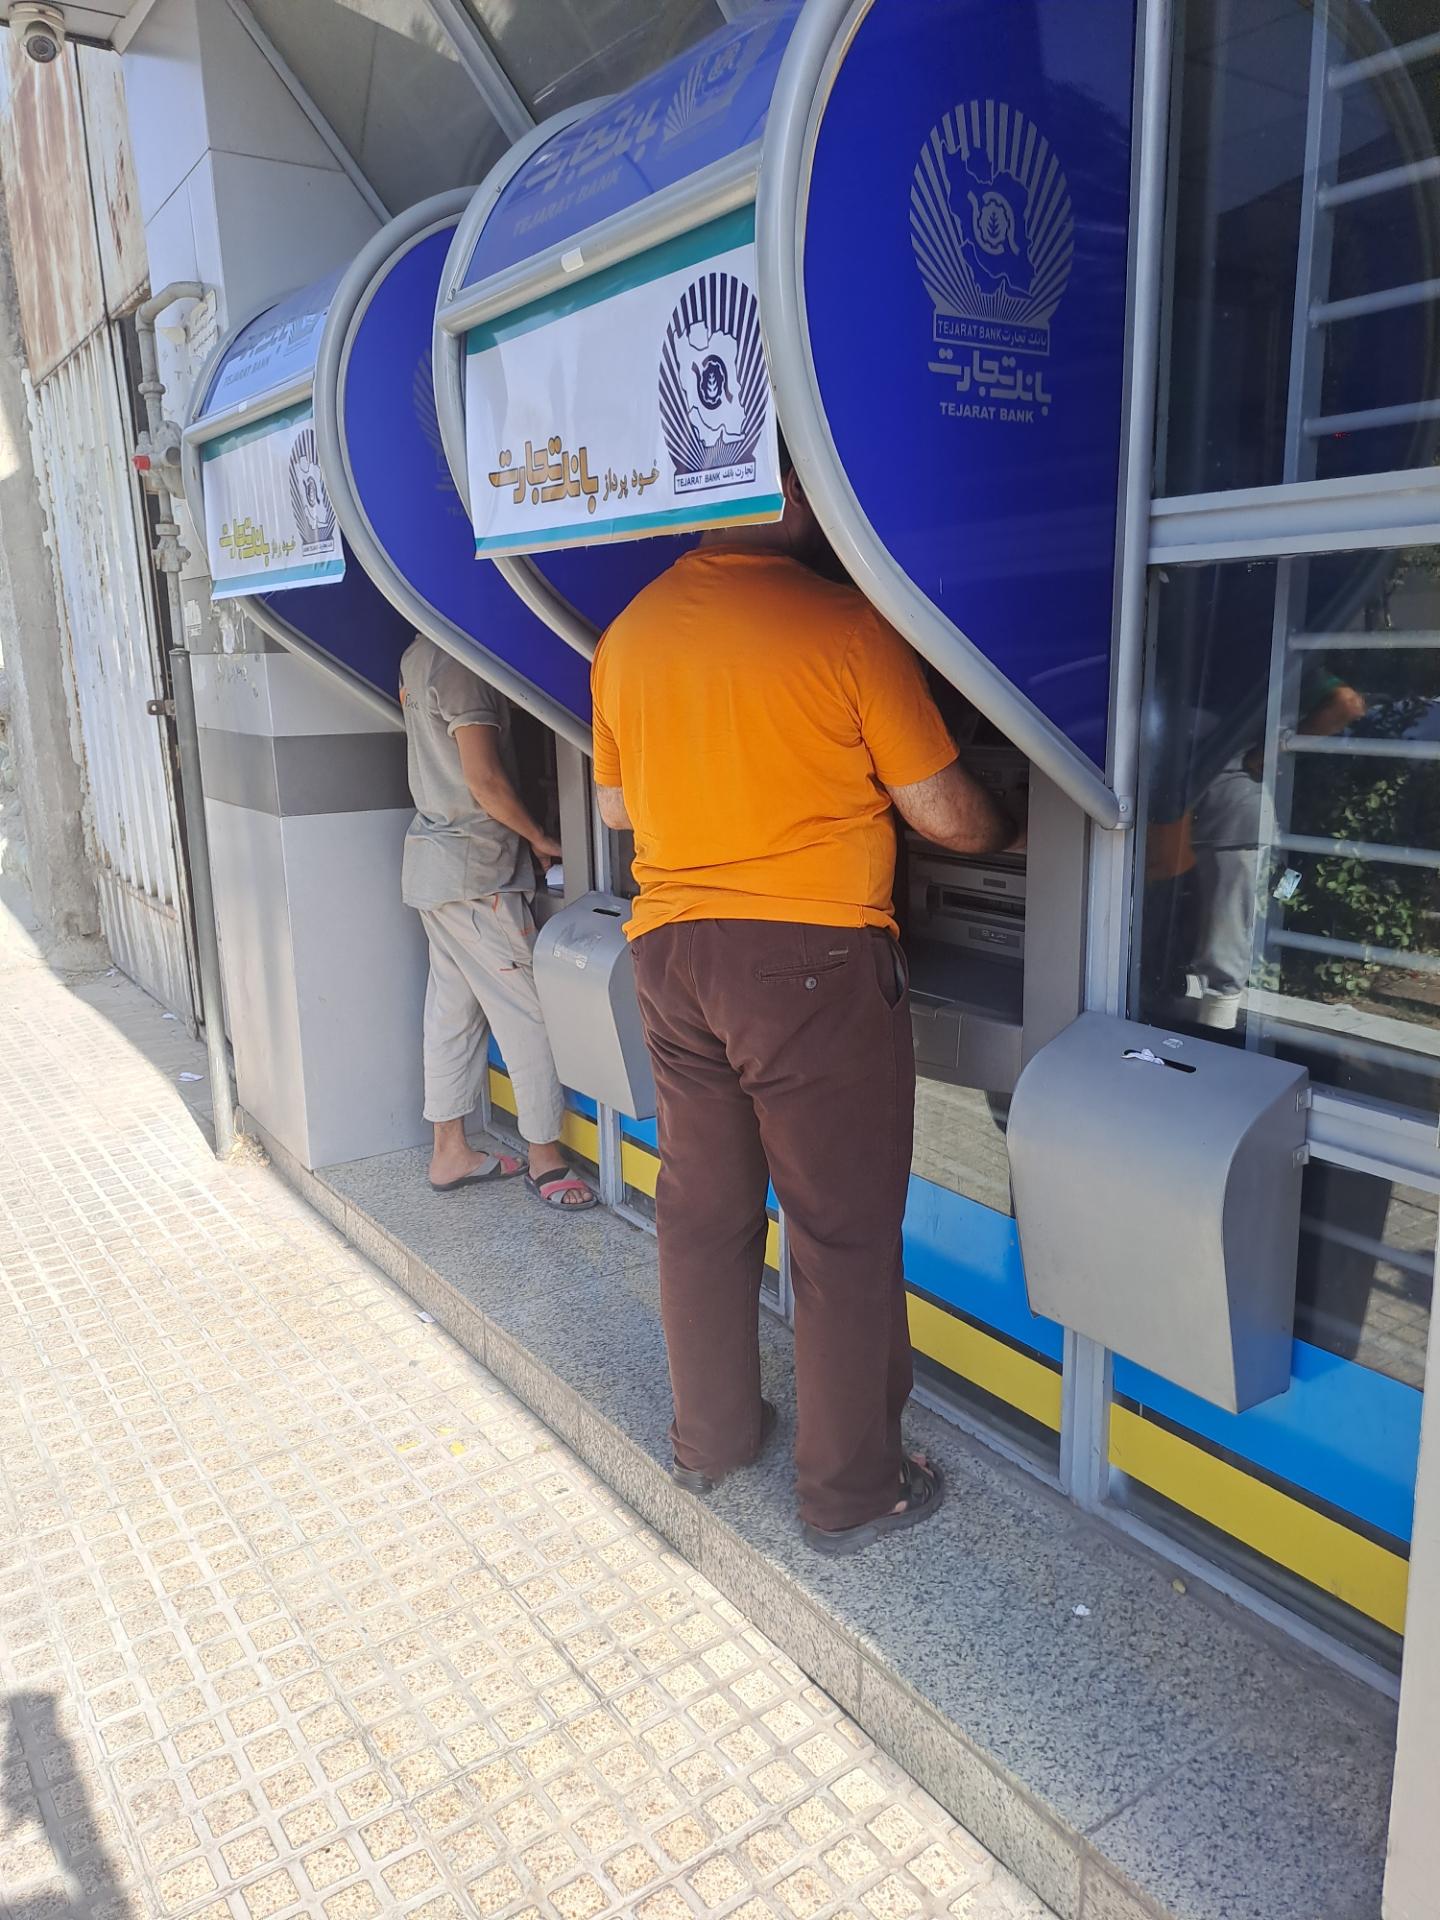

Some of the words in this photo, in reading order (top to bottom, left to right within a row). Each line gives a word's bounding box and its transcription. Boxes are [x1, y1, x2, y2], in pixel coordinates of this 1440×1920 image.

[576, 165, 624, 205] BANK
[938, 320, 978, 338] TEJARAT
[978, 326, 1001, 342] BANK
[1000, 329, 1027, 348] تجارت
[928, 348, 1017, 398] تجارت
[939, 402, 996, 420] TEJARAT
[1000, 408, 1034, 423] BANK
[488, 435, 563, 506] تجارت
[603, 467, 629, 501] پرداز
[631, 459, 660, 496] خود
[676, 475, 703, 489] TEJARAT
[704, 471, 721, 484] BANK
